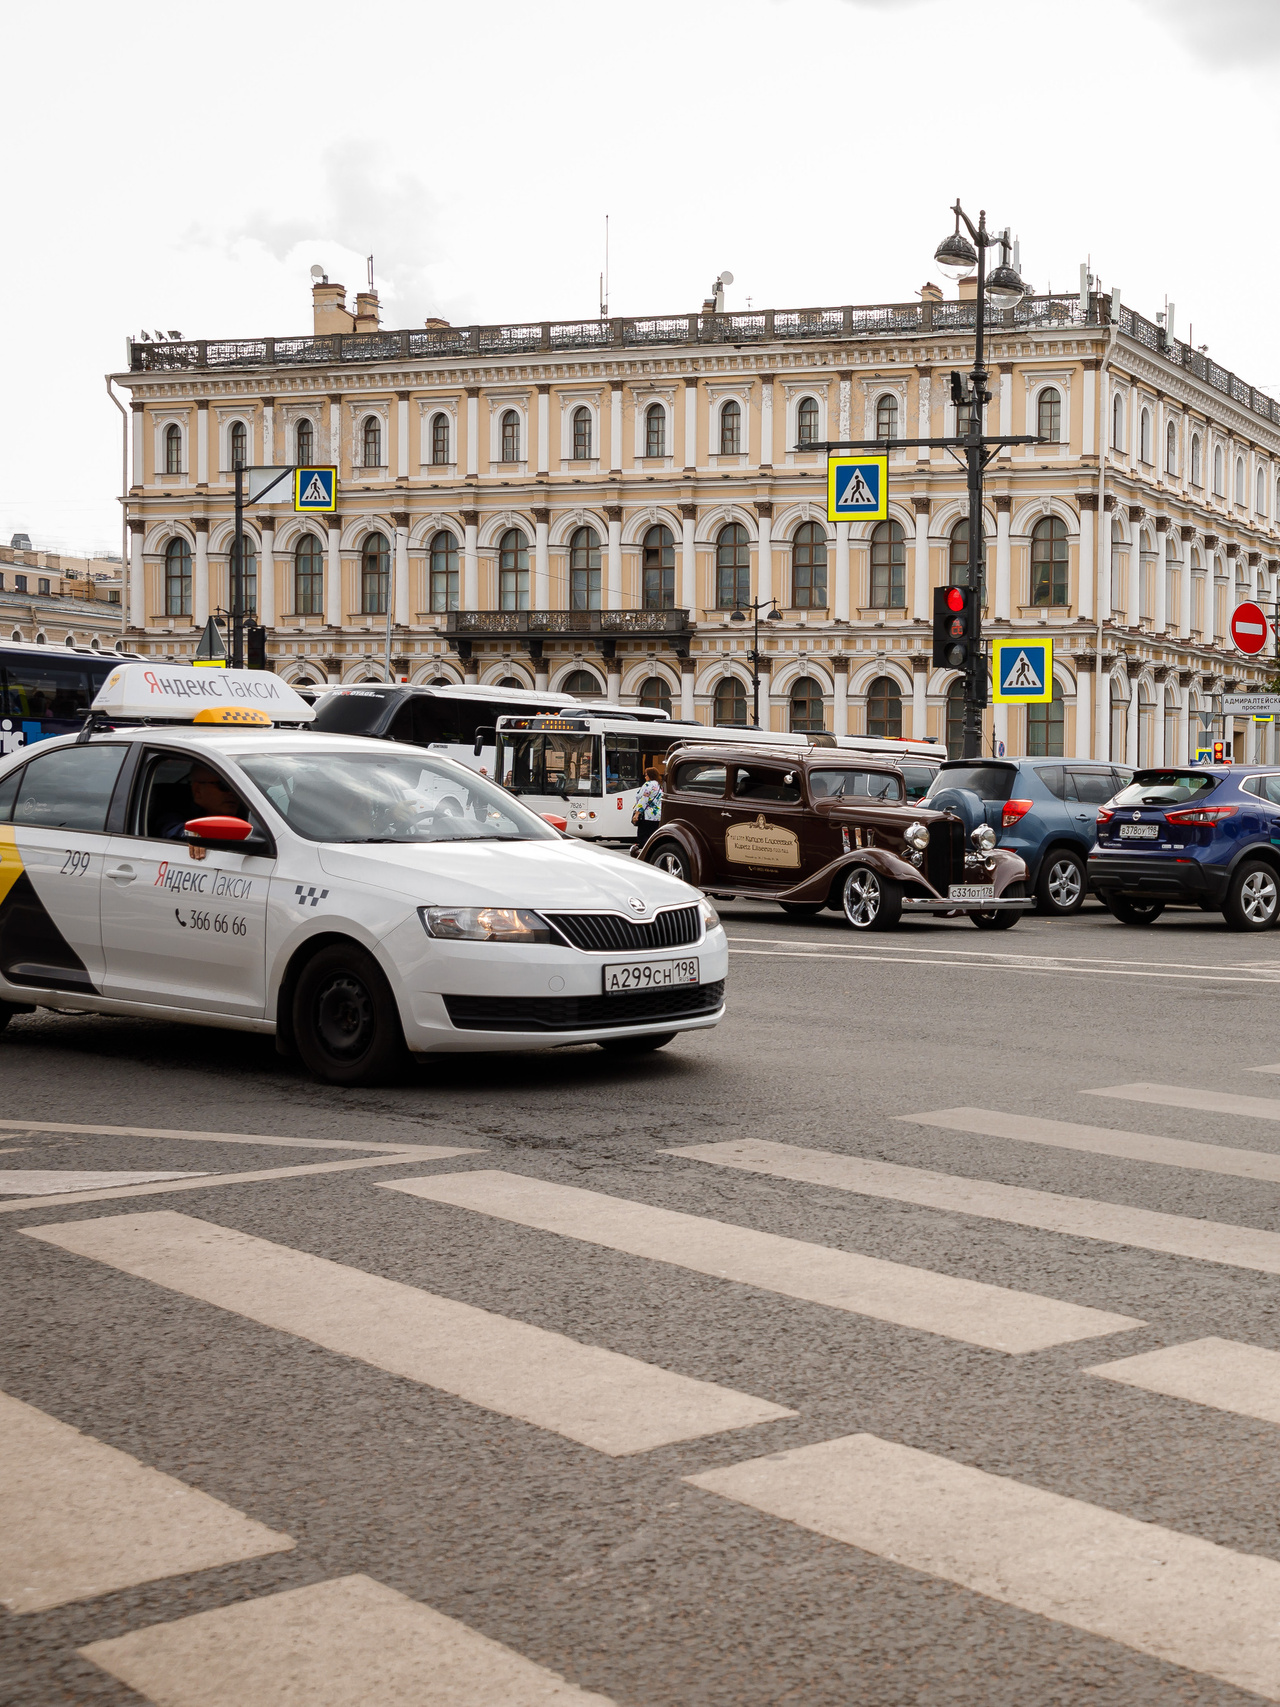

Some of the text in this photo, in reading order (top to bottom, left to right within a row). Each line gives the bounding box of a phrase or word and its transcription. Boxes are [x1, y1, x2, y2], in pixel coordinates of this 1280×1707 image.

[144, 671, 280, 699] Яндекс Такси
[60, 850, 91, 877] 299
[154, 861, 252, 899] Яндекс Такси
[190, 910, 247, 936] 366 66 66
[610, 961, 696, 989] А299СН 198
